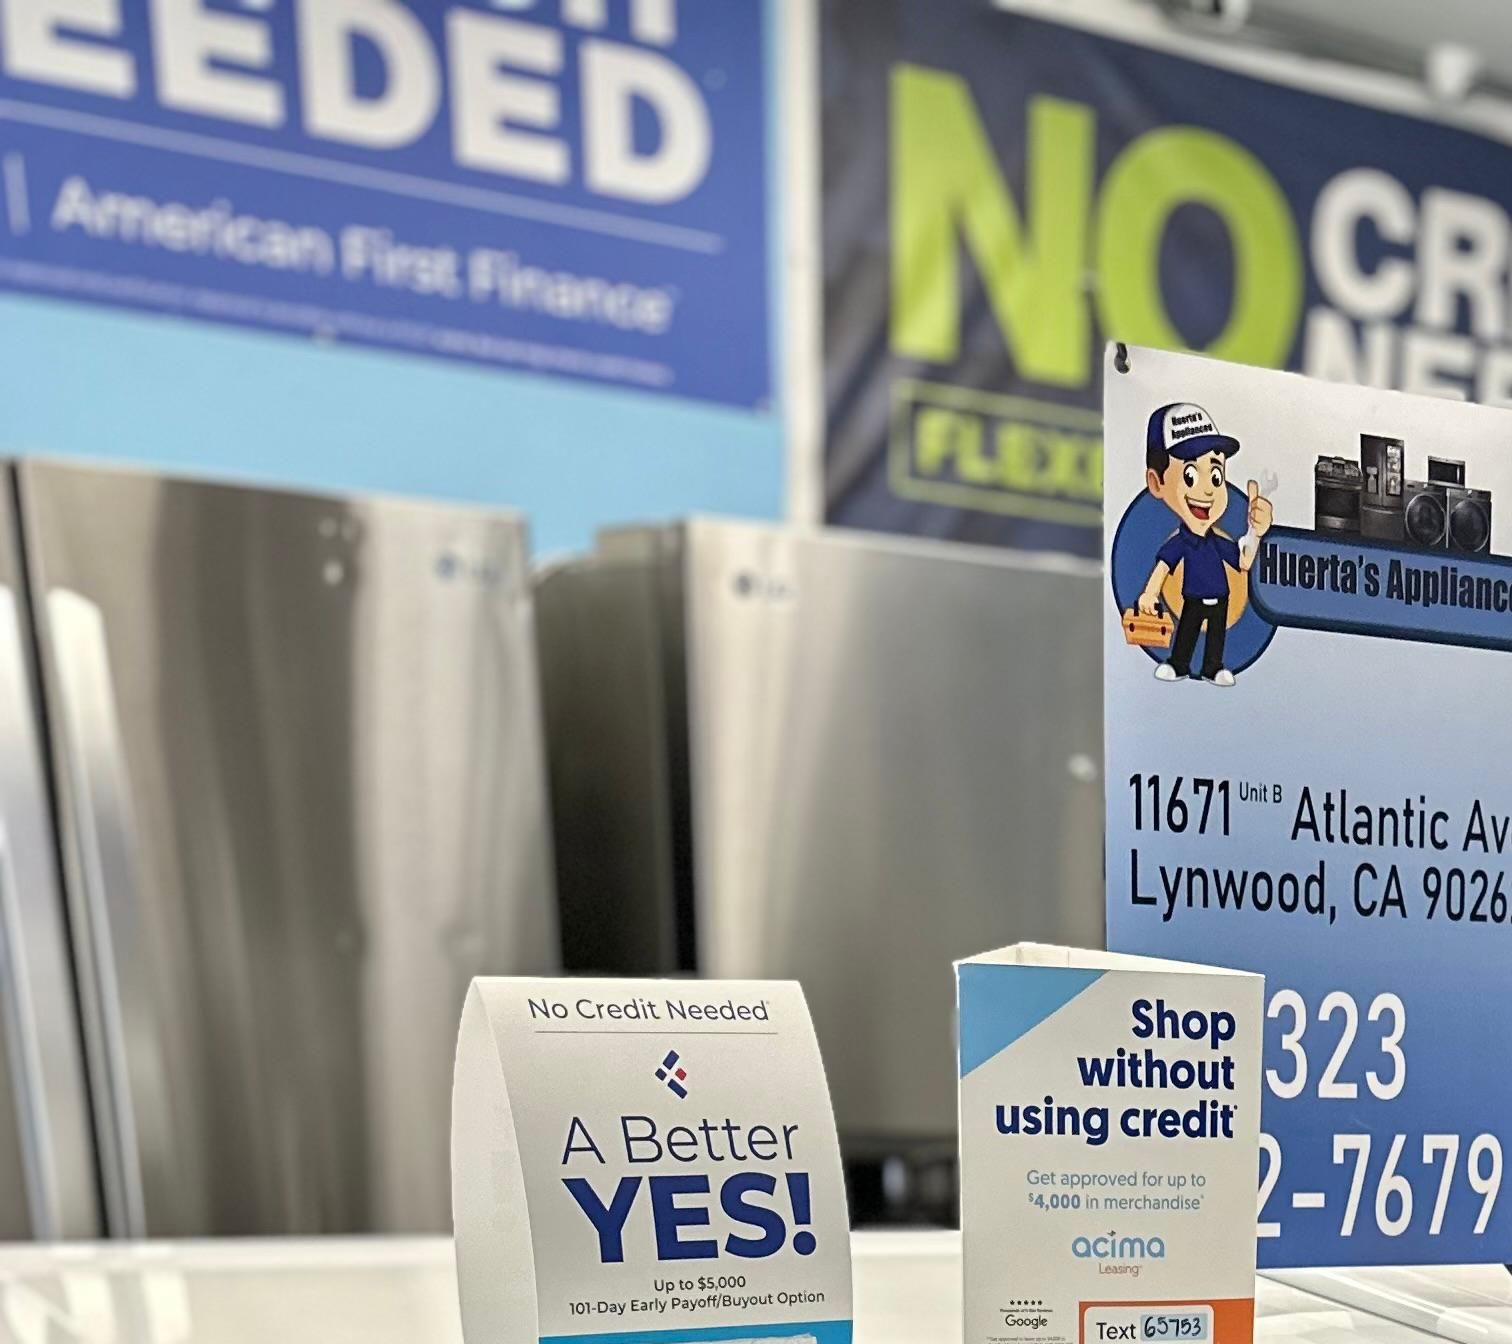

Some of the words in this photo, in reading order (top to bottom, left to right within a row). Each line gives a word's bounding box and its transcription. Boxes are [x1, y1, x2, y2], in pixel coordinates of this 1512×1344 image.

[888, 62, 1304, 388] NO
[51, 175, 333, 277] American
[341, 224, 462, 300] First
[469, 247, 675, 334] Finance
[1259, 543, 1380, 598] Huerta's
[1129, 773, 1231, 836] 11671
[1239, 781, 1269, 803] Unit
[1272, 784, 1282, 804] B
[1291, 786, 1449, 850] Atlantic
[1130, 848, 1337, 925] Lynwood,
[1353, 863, 1408, 918] CA
[528, 997, 568, 1020] No
[576, 998, 660, 1021] Credit
[1131, 998, 1237, 1050] Shop
[1077, 1047, 1235, 1091] without
[1265, 989, 1407, 1100] 323
[561, 1116, 606, 1166] A
[621, 1114, 799, 1164] Better
[995, 1095, 1109, 1146] using
[1026, 1169, 1057, 1186] Get
[1060, 1171, 1137, 1189] approved
[1142, 1171, 1164, 1187] for
[1167, 1174, 1187, 1190] up
[1191, 1173, 1207, 1187] to
[1028, 1192, 1081, 1212] $4,000
[1085, 1195, 1099, 1210] in
[560, 1171, 817, 1264] YES!
[1071, 1231, 1165, 1258] acima
[569, 1300, 627, 1316] 101-Day
[629, 1296, 669, 1313] Early
[671, 1291, 774, 1312] Payoff/Buyout
[776, 1289, 826, 1307] Option
[653, 1278, 676, 1294] Up
[678, 1277, 694, 1292] to
[696, 1275, 746, 1292] $5,000
[1004, 1314, 1048, 1330] Google
[1096, 1322, 1137, 1340] Text
